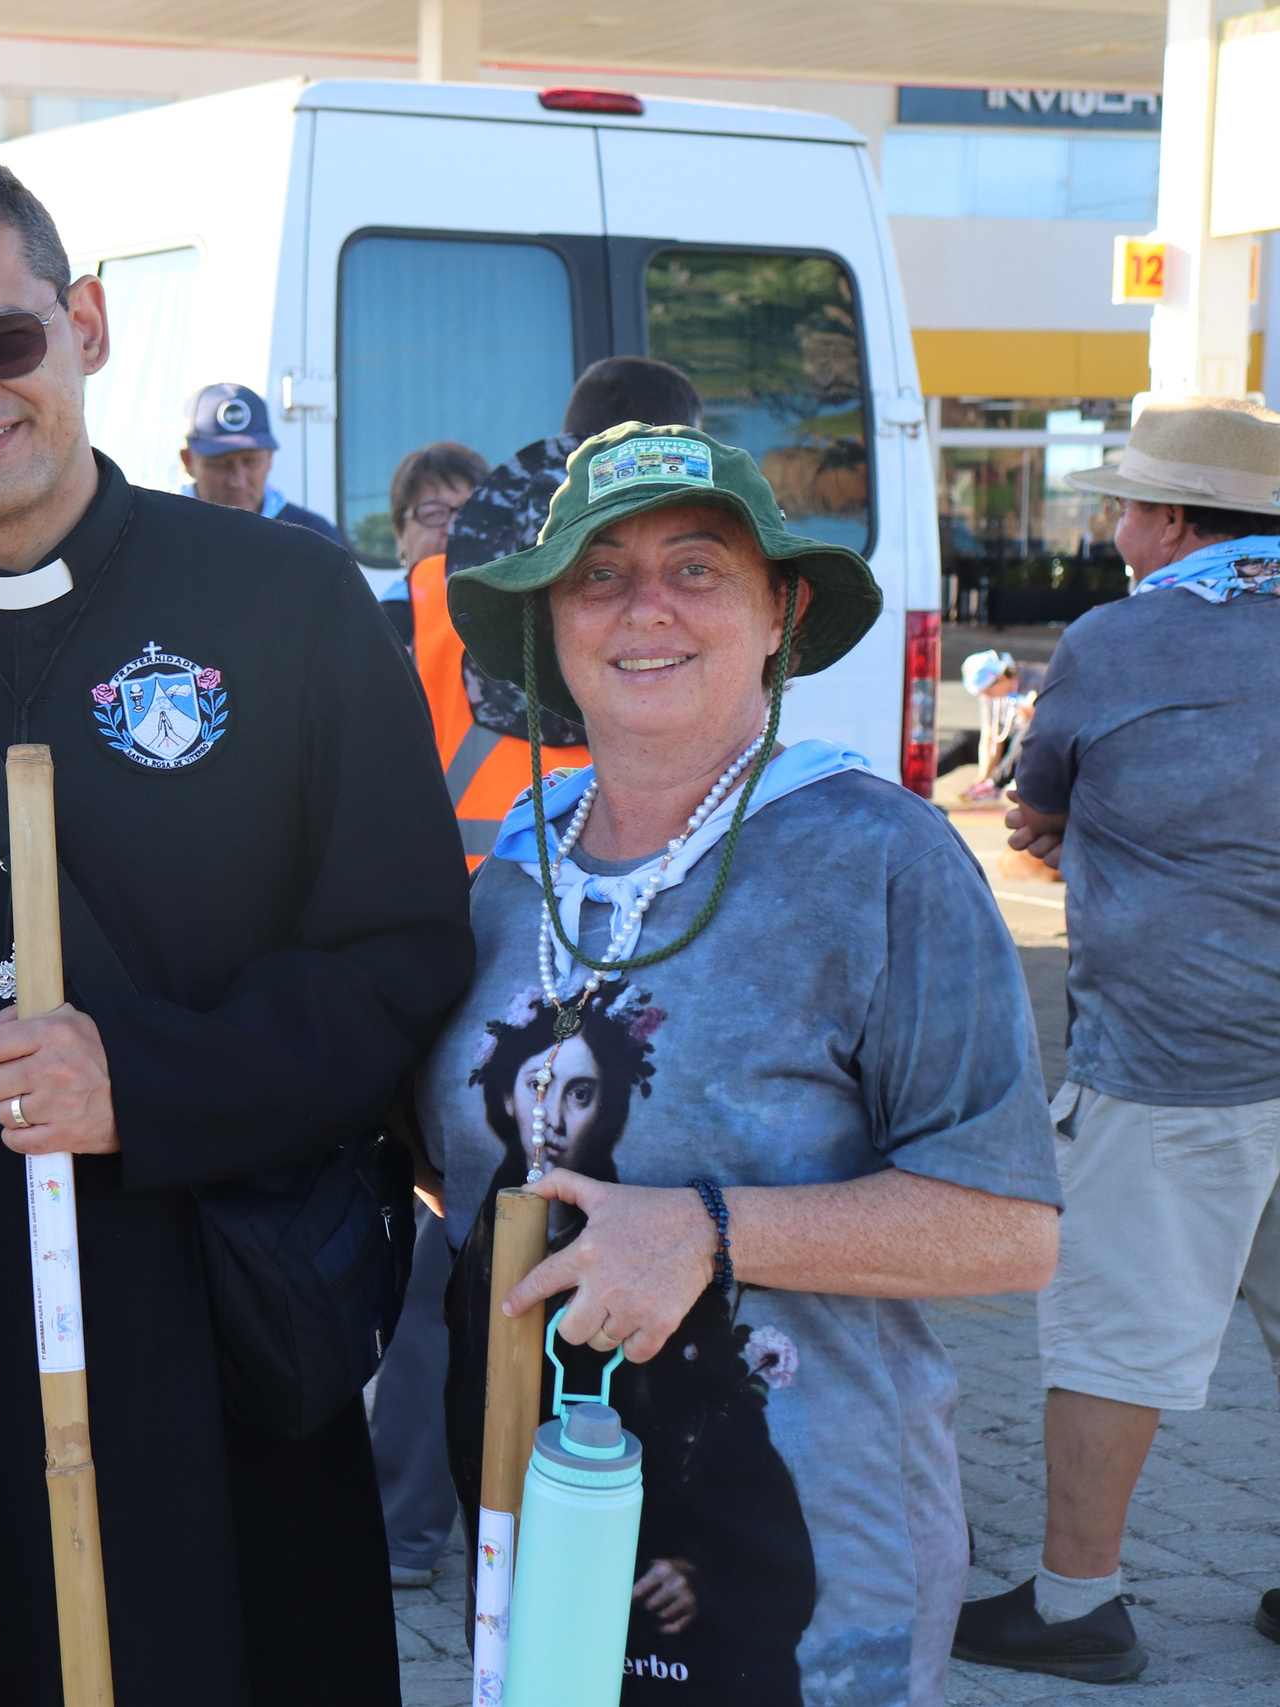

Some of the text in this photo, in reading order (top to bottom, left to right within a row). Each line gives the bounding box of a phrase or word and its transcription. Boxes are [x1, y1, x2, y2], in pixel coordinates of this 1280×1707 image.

[1131, 255, 1164, 286] 12
[617, 445, 707, 459] PITANGA
[690, 442, 708, 452] DE
[114, 655, 198, 682] FRATERNIDADE
[126, 749, 149, 766] SANTA
[152, 760, 171, 769] ROSA
[174, 759, 184, 768] DE
[623, 1654, 689, 1682] erbo
